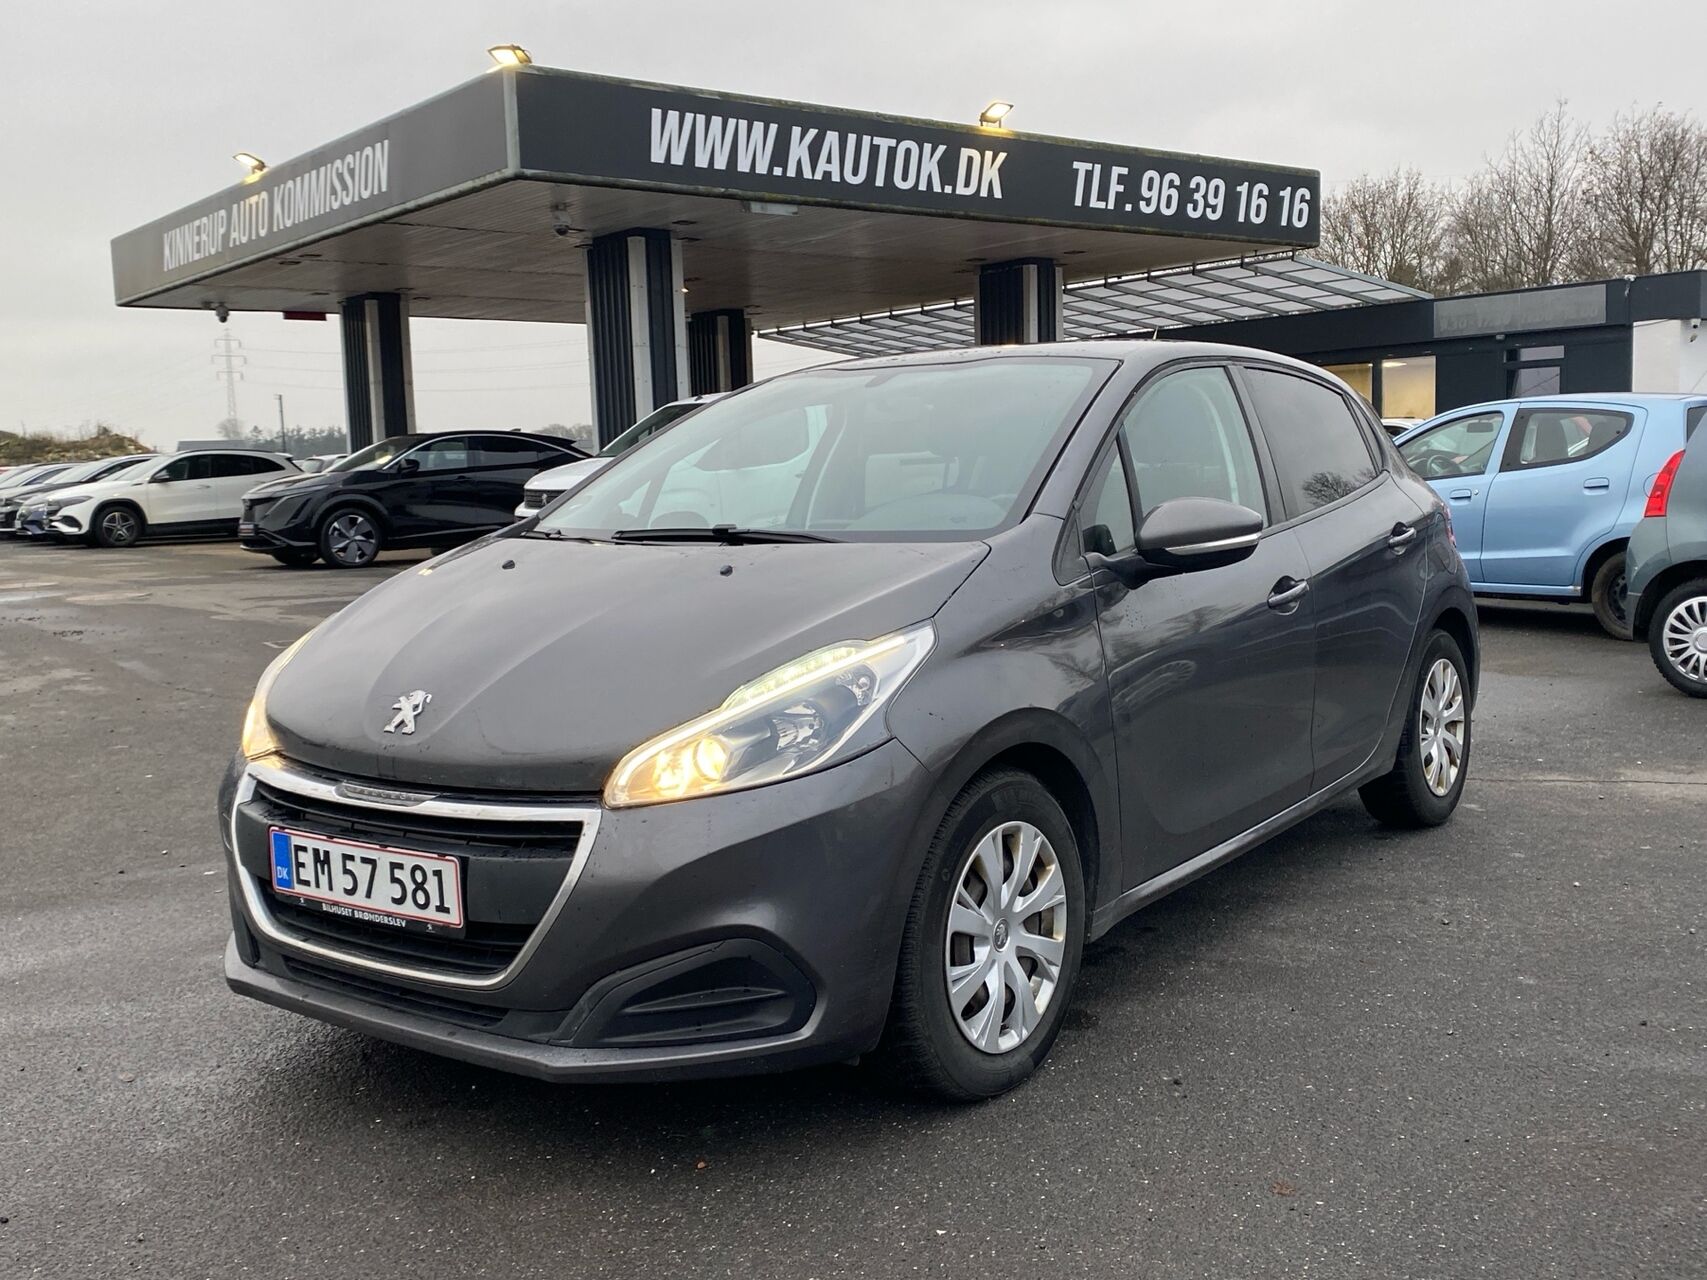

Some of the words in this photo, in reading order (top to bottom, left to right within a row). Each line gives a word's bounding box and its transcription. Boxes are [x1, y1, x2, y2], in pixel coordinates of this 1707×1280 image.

[650, 107, 1008, 199] WWW.KAUTOK.DK
[164, 209, 226, 272] KINNERUP
[229, 191, 269, 247] AUTO
[273, 140, 389, 232] KOMMISSION
[1073, 161, 1133, 212] TLF.
[1139, 170, 1181, 216] 96
[1187, 175, 1226, 221] 39
[1236, 181, 1269, 225] 16
[1279, 186, 1311, 228] 16
[276, 866, 289, 880] DK
[293, 844, 333, 892] EM
[341, 853, 378, 899] 57
[389, 861, 450, 914] 581
[322, 903, 352, 917] BILHUSET
[354, 909, 407, 928] BRØNDERSLEV
